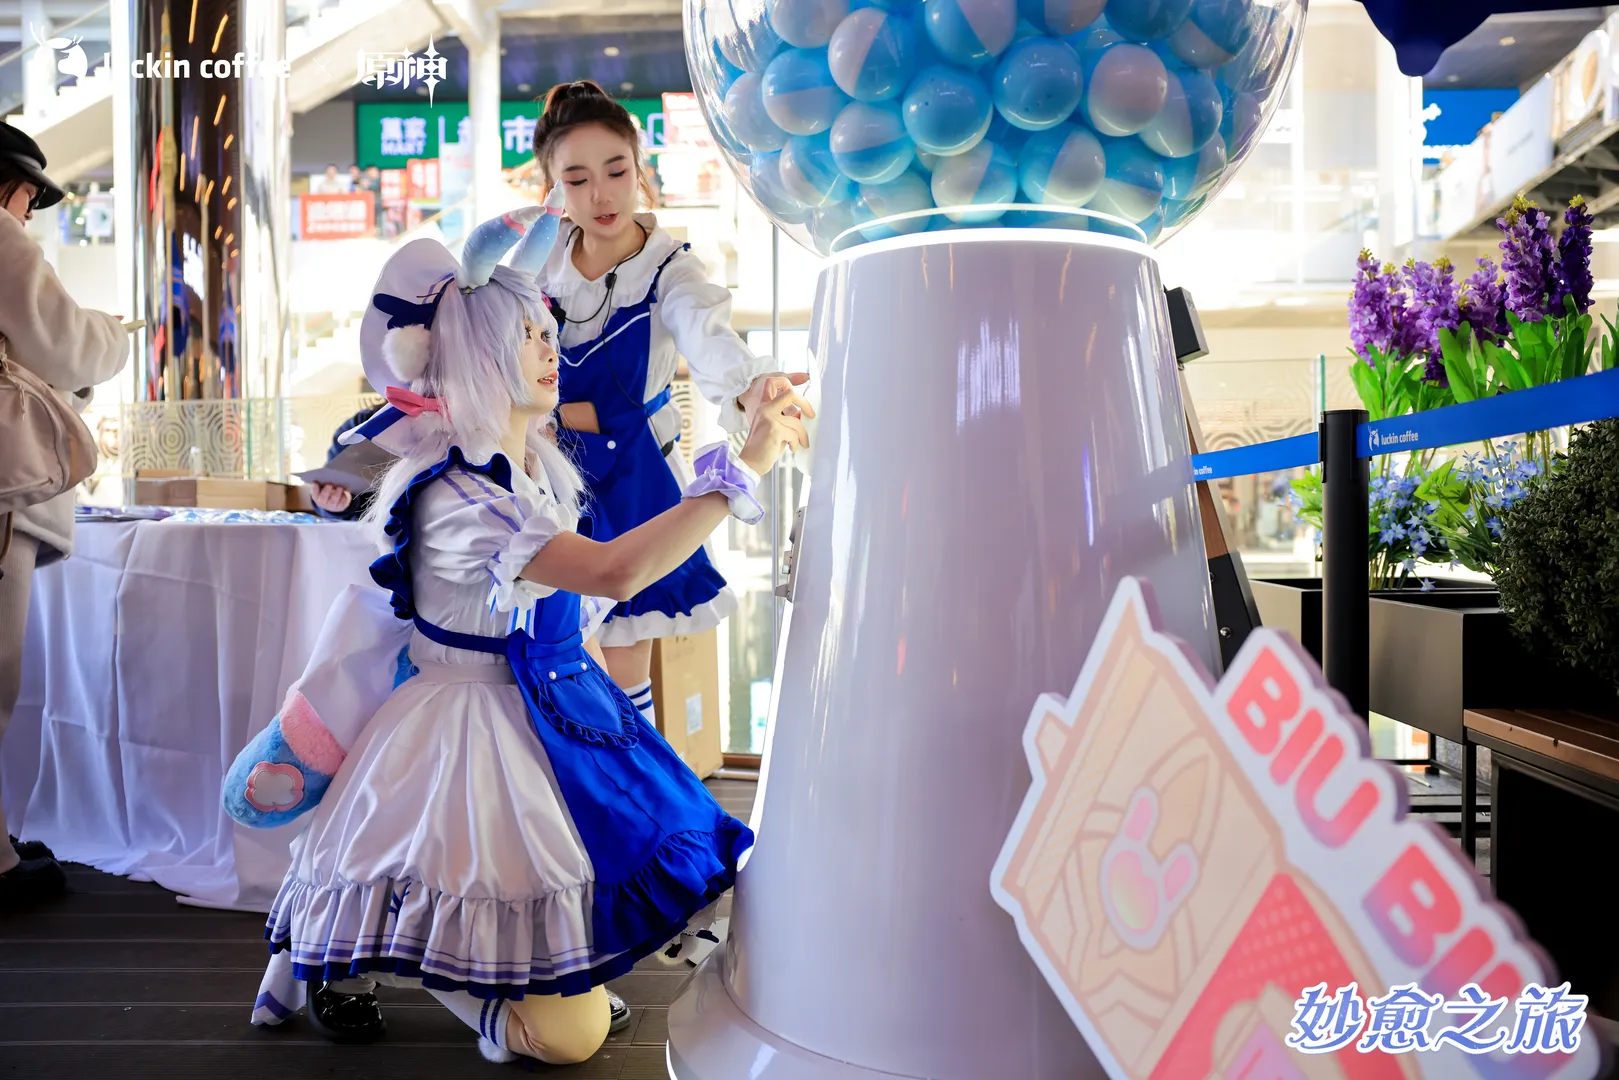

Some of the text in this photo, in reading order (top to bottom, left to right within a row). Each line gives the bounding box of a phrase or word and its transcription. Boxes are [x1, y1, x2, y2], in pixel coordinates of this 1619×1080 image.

[1381, 430, 1419, 446] luckin coffee
[1227, 645, 1380, 849] BIU
